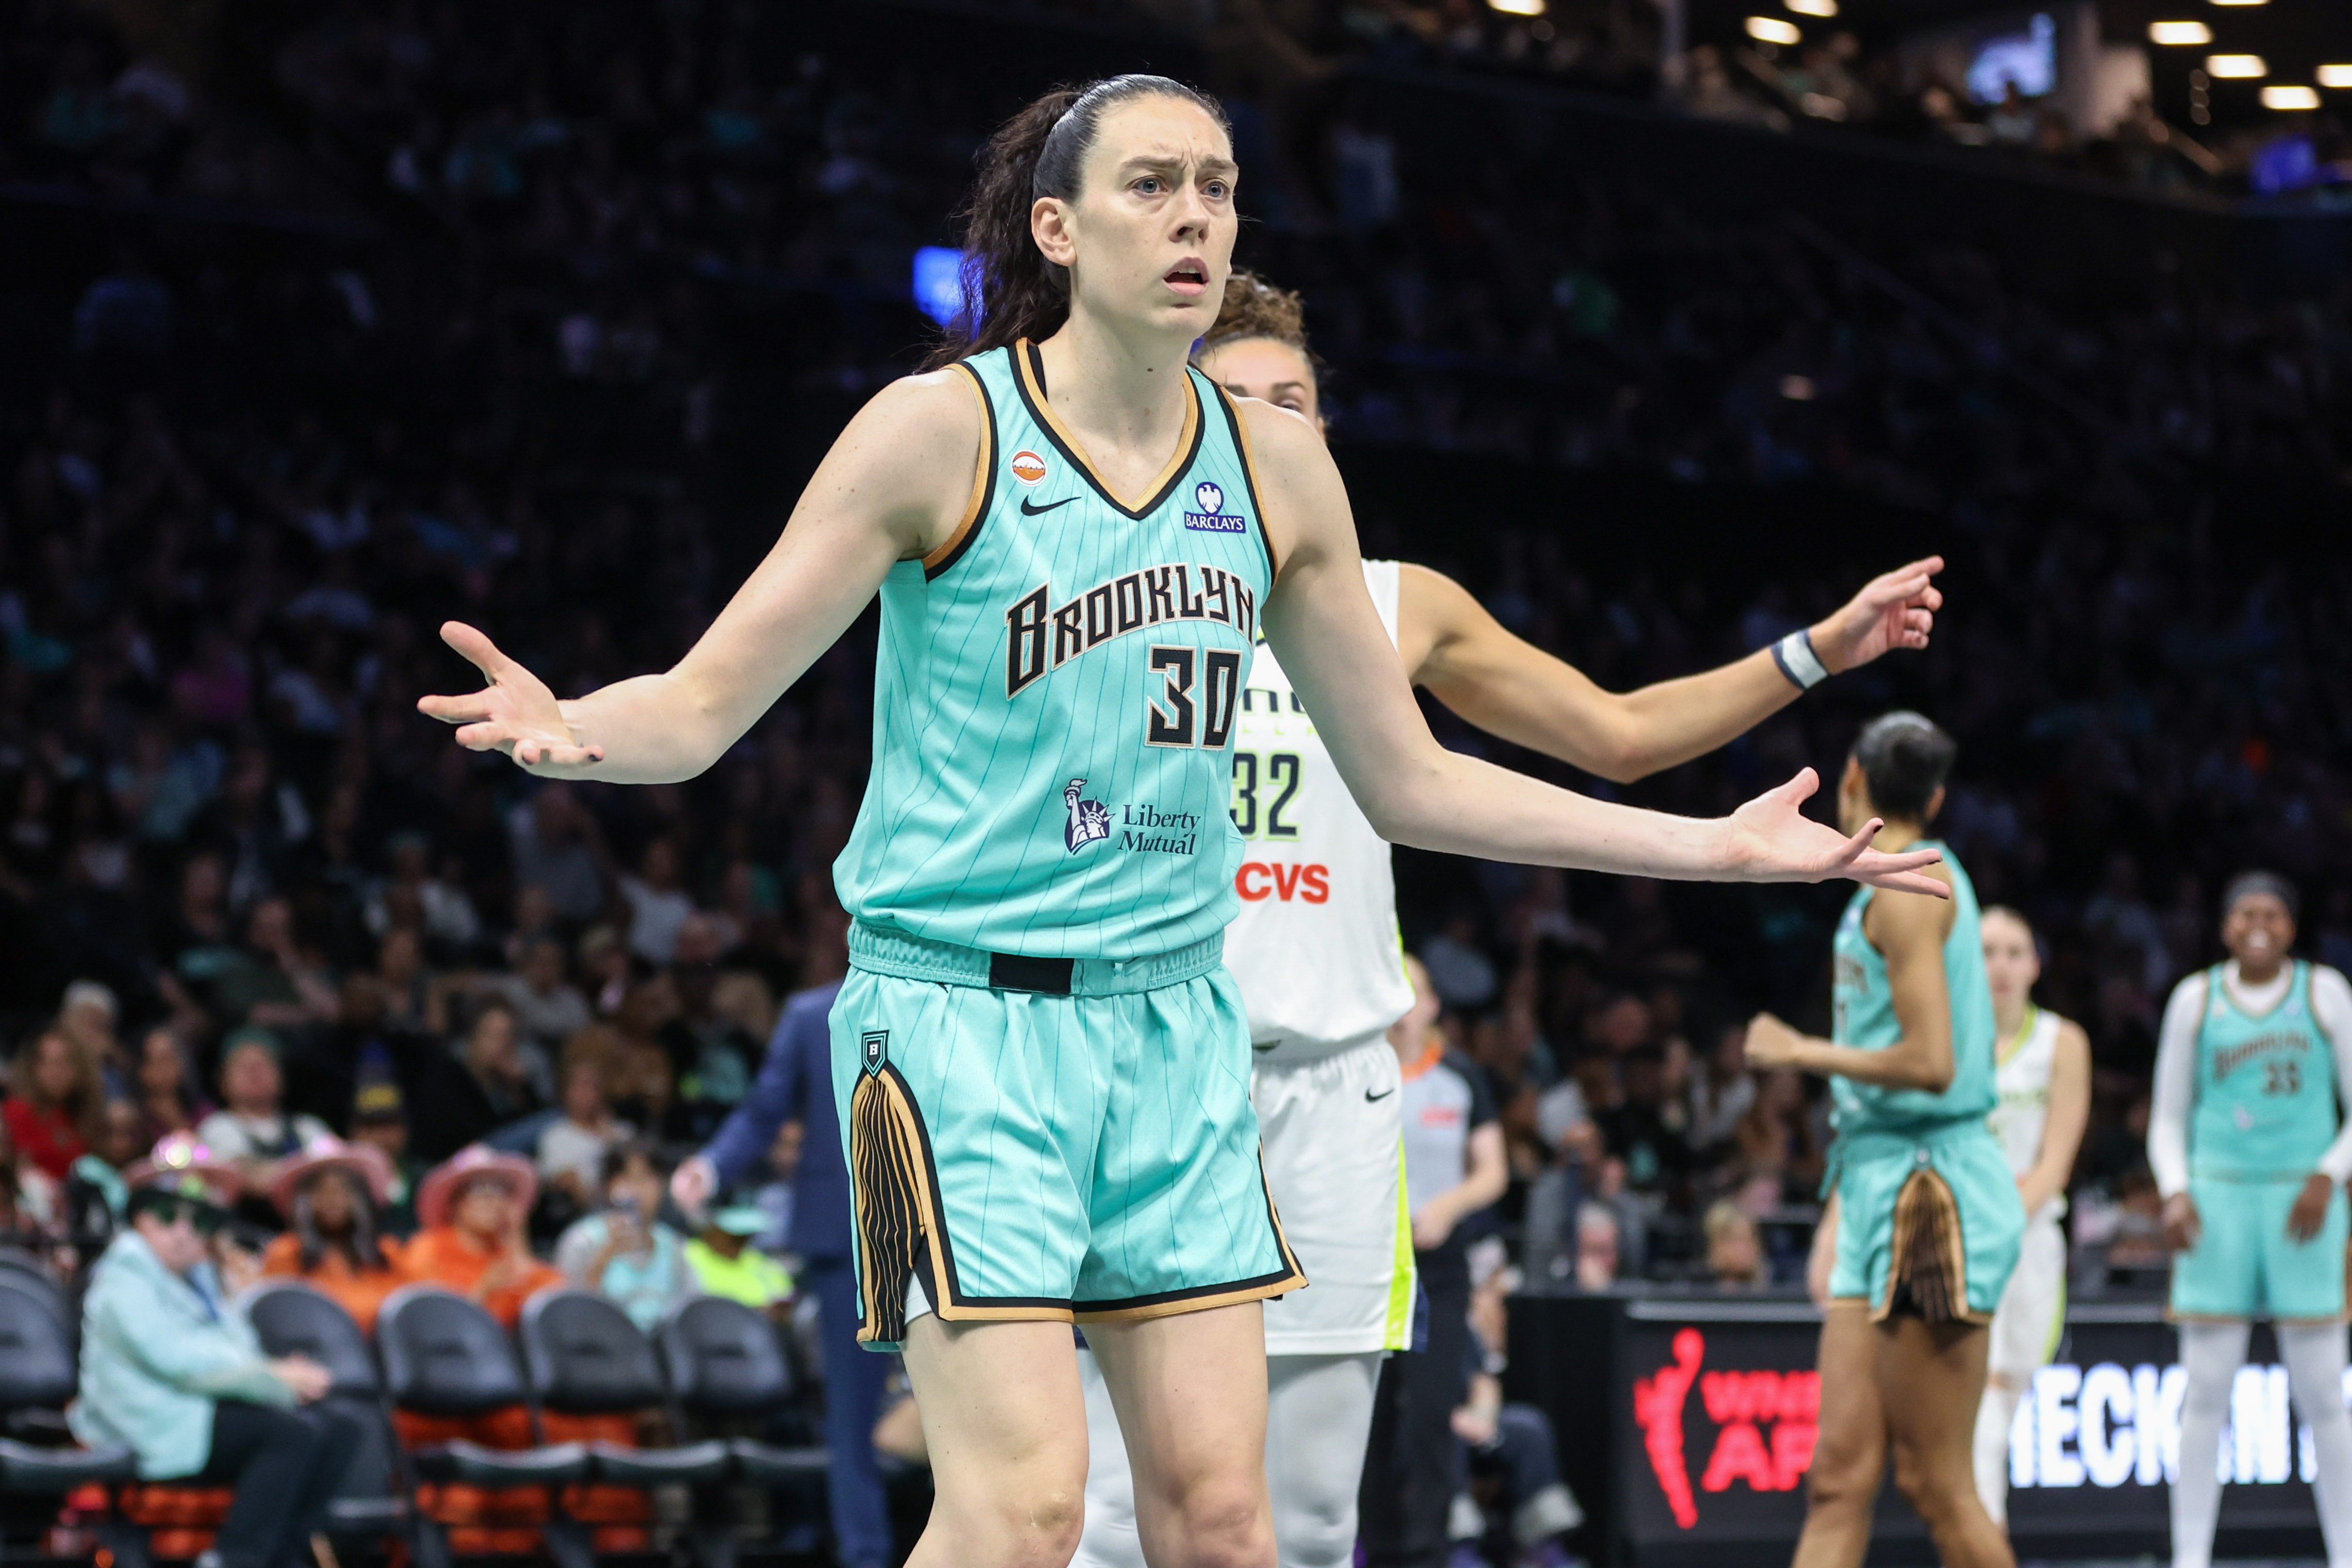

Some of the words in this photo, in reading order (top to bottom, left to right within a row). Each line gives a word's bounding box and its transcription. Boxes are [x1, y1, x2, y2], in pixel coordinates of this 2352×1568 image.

[1186, 514, 1243, 531] BARCLAYS
[1005, 562, 1254, 701] BROOKLYN
[1145, 643, 1242, 750] 30
[1231, 751, 1302, 839] 32
[1122, 804, 1201, 838] Liberty
[1117, 831, 1196, 855] Mutual
[1235, 862, 1329, 904] CVS
[869, 1044, 878, 1055] B
